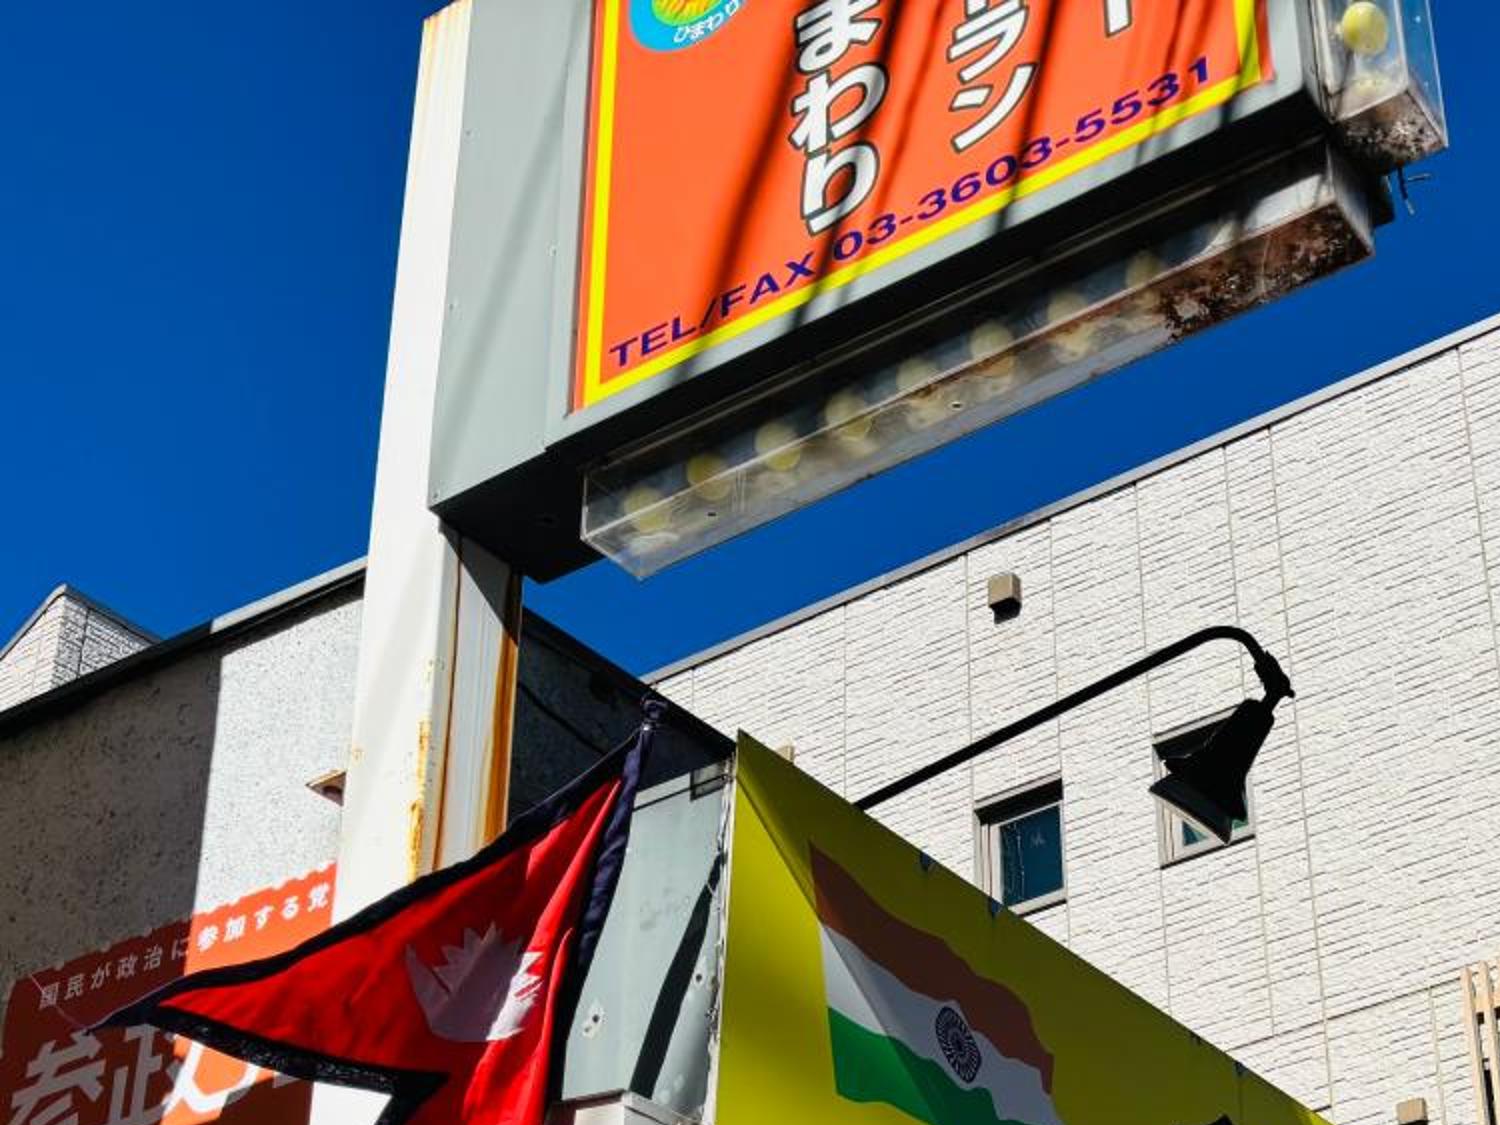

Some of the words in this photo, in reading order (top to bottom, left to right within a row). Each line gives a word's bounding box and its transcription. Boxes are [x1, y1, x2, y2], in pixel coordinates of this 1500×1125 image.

[946, 0, 1038, 153] ラン
[608, 252, 816, 368] TEL/FAX
[833, 56, 1211, 262] 03-3603-5531
